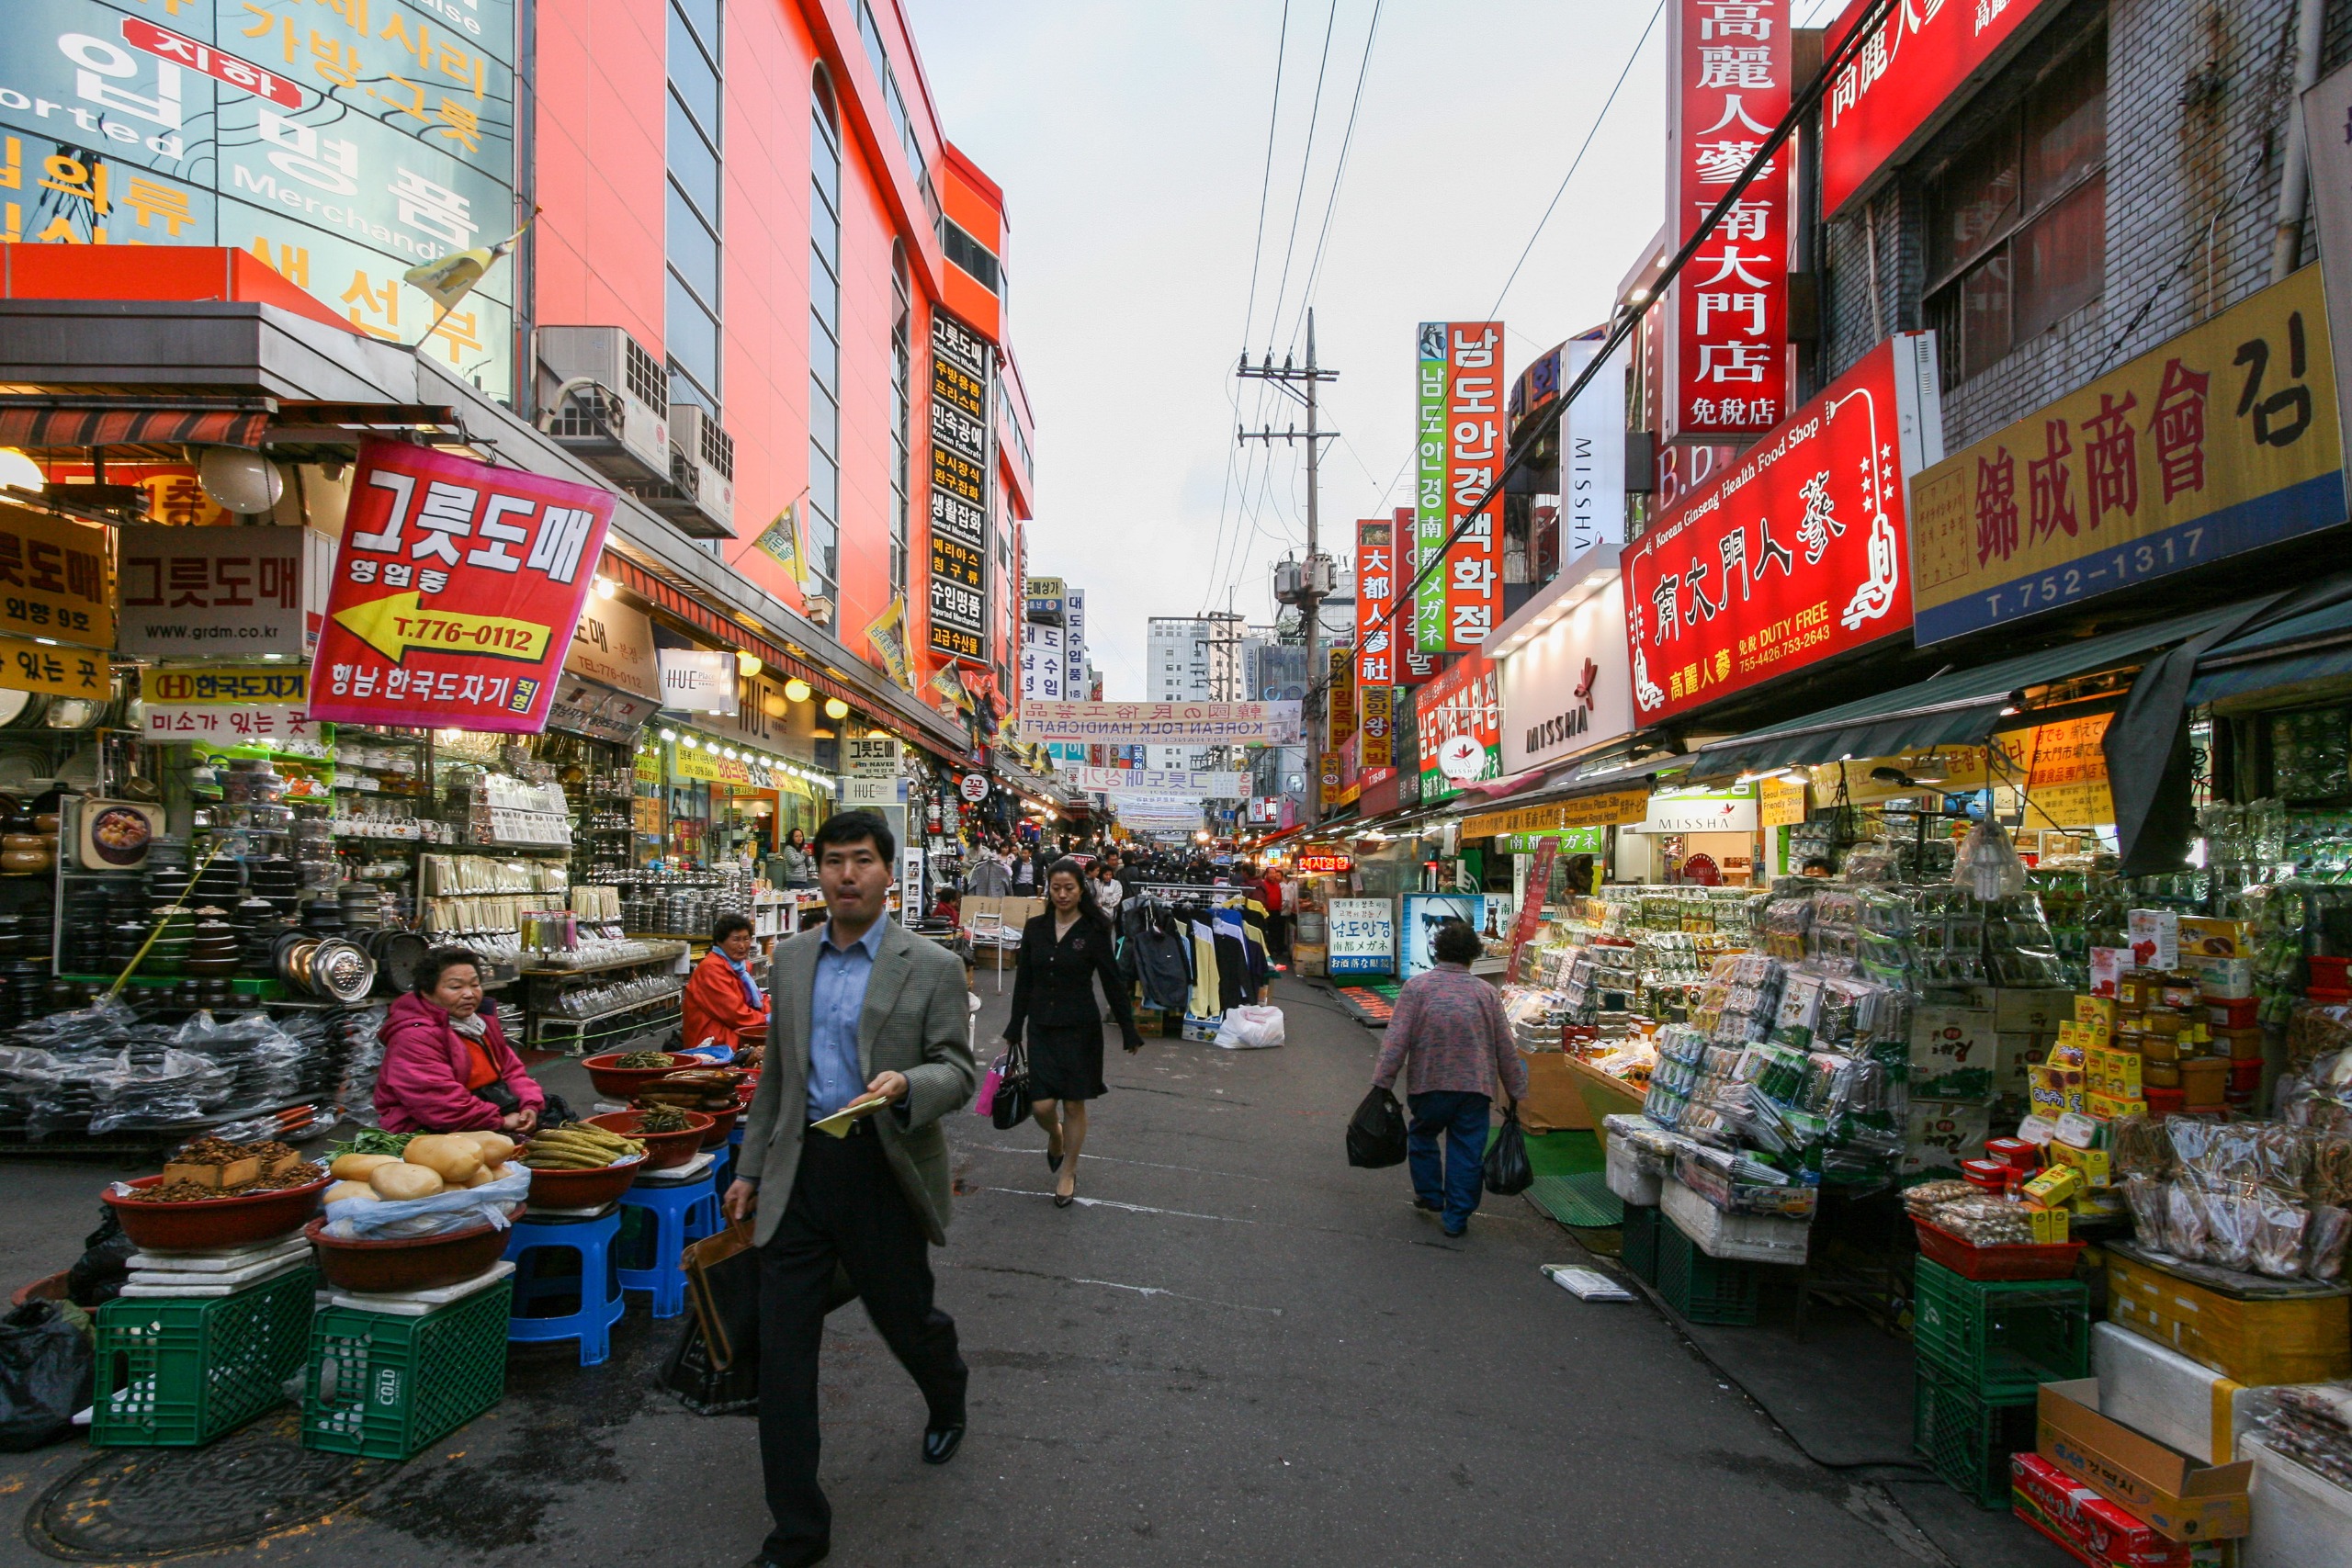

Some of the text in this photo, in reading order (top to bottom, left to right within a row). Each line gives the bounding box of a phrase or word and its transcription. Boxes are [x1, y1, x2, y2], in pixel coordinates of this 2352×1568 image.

[153, 32, 277, 96] 지하
[58, 33, 181, 131] 입
[234, 164, 446, 261] Merchandi
[933, 317, 982, 367] 그릇도매
[933, 339, 982, 377] Kitchenware Wholesale
[935, 360, 980, 398] 주방용품
[2233, 311, 2312, 447] 김
[935, 379, 979, 416] 프라스틱
[933, 404, 982, 451] 민속공예
[933, 428, 981, 460] Korean Folkcraft
[935, 449, 980, 483] 팬시장식
[1975, 358, 2210, 570] 錦成商會
[1453, 328, 1498, 644] 남도안경백화점
[1575, 438, 1591, 549] MISSHA
[1656, 417, 1818, 549] Korean Ginseng Health Food Shop
[350, 469, 595, 585] 그릇도매
[932, 492, 981, 535] 생활잡화
[932, 517, 981, 545] General Merchandise
[933, 538, 978, 567] 메리야스
[125, 557, 296, 608] 그릇도매
[350, 559, 448, 594] 영업중
[931, 581, 980, 618] 수입명품
[931, 604, 980, 628] Imported Merchandise
[58, 608, 90, 632] 9호
[393, 616, 532, 651] T.776-0112
[1759, 616, 1791, 648] DUTY
[1795, 600, 1829, 631] FREE
[1069, 596, 1081, 681] 대도수입품
[17, 650, 97, 687] 있는 곳
[196, 674, 304, 698] 한국도자기
[578, 655, 642, 689] TEL:776-0112
[668, 670, 697, 689] HUE
[511, 680, 531, 710] 직영
[1069, 690, 1080, 698] 1층
[153, 711, 308, 735] 미소가 있는 곳
[1526, 705, 1588, 753] MISSHA
[850, 741, 894, 759] 그릇도매
[717, 756, 749, 783] BB크림
[854, 784, 875, 798] HUE
[966, 779, 984, 797] 꽃
[1788, 797, 1802, 806] Shop
[1659, 818, 1729, 829] MISSHA
[1510, 834, 1597, 851] 南都ガネ
[1331, 920, 1390, 939] 남도안경
[380, 1369, 395, 1405] COLD
